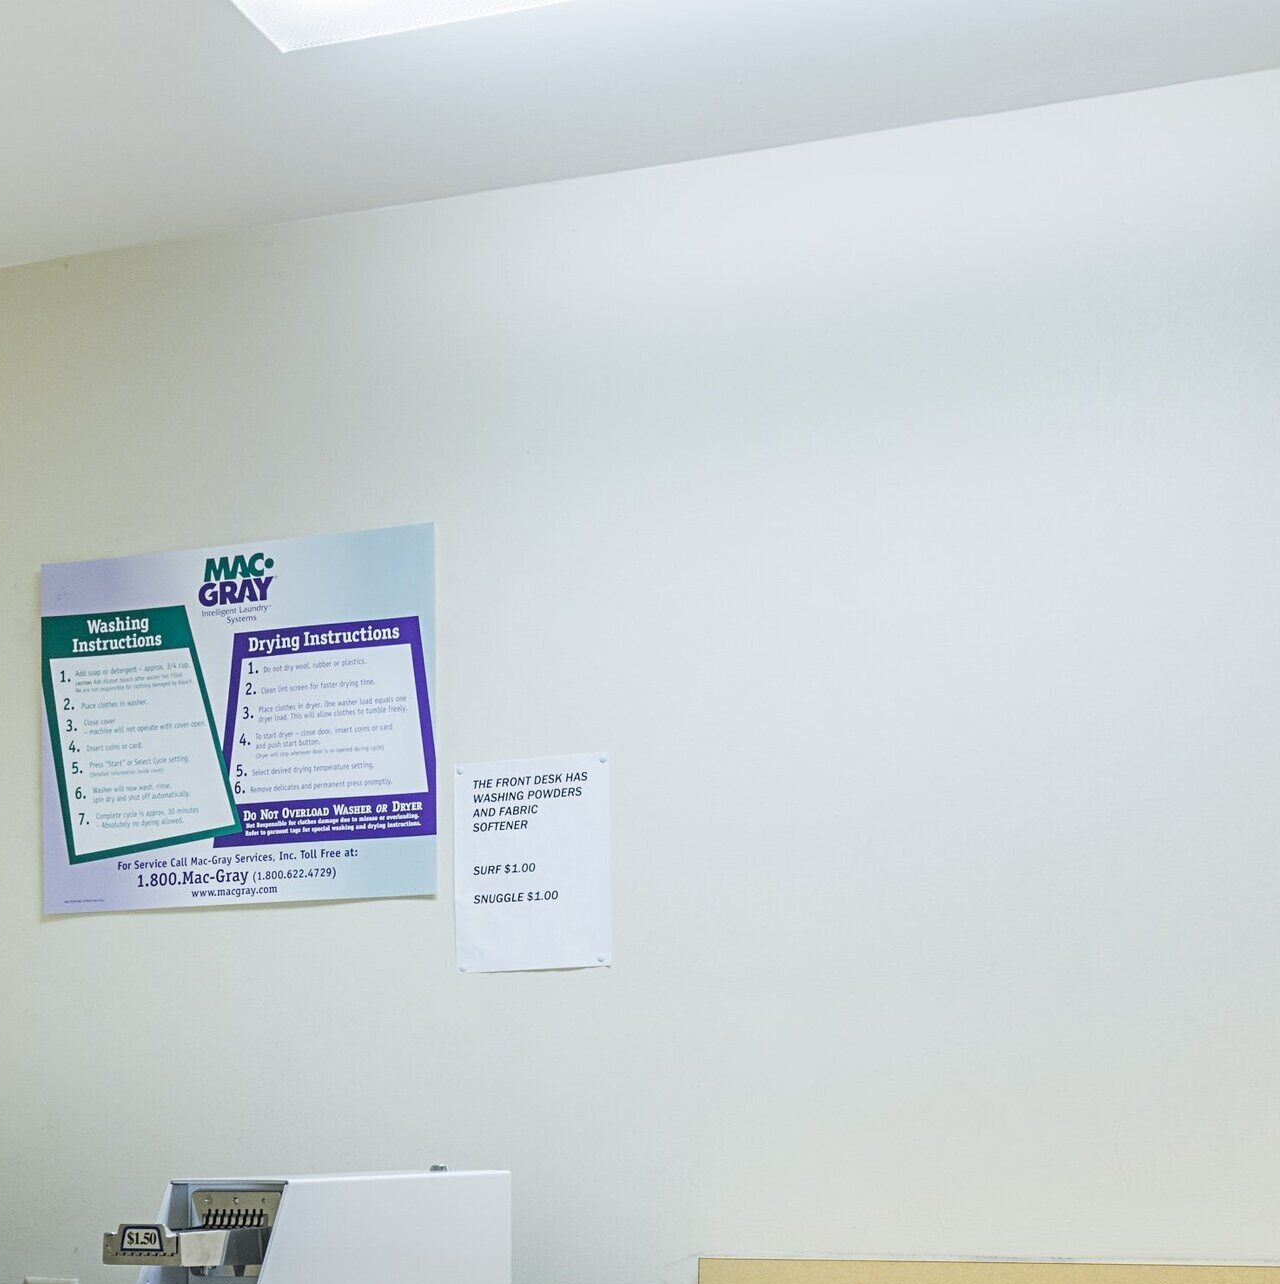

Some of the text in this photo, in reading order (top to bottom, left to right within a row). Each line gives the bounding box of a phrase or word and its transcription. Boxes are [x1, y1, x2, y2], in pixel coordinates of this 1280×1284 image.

[198, 576, 274, 607] GRAY
[201, 608, 237, 618] Intelligent
[86, 616, 149, 634] Washing
[226, 615, 257, 626] Systems
[72, 633, 162, 653] Instructions
[248, 625, 400, 654] Drying Instructions
[248, 661, 258, 674] 1.
[342, 658, 367, 667] plastics.
[60, 670, 71, 683] 1.
[246, 682, 256, 696] 2.
[340, 680, 358, 688] drying
[64, 698, 74, 710] 2.
[242, 706, 254, 720] 3.
[374, 696, 394, 704] equals
[258, 716, 272, 724] dryer
[334, 708, 356, 717] clothes
[366, 706, 386, 714] tumble
[388, 704, 408, 712] freely.
[66, 719, 78, 732] 3.
[68, 740, 80, 752] 4.
[239, 733, 250, 746] 4.
[72, 762, 83, 774] 5.
[236, 764, 247, 777] 5.
[270, 767, 292, 775] desired
[292, 766, 312, 774] drying
[314, 764, 350, 772] temperature
[234, 781, 245, 794] 6.
[273, 784, 300, 792] delicates
[314, 781, 345, 790] permanent
[364, 778, 392, 786] promptly.
[472, 772, 588, 790] THE FRONT DESK HAS
[75, 787, 86, 800] 6.
[473, 786, 582, 804] WASHING POWDERS
[472, 804, 538, 818] AND FABRIC
[78, 812, 90, 825] 7.
[267, 828, 289, 836] garment
[312, 825, 330, 833] special
[368, 822, 386, 830] drying
[472, 820, 528, 832] SOFTENER
[117, 848, 358, 870] For Service Call Mac-Gray Services, Inc. Toll Free at:
[473, 862, 536, 876] SURF $1.00
[137, 867, 337, 888] 1.800.Mac-Gray (1.800.622.4729)
[191, 886, 278, 898] www.macgray.com
[474, 890, 559, 904] SNUGGLE $1.00
[126, 1232, 157, 1246] $1.50
